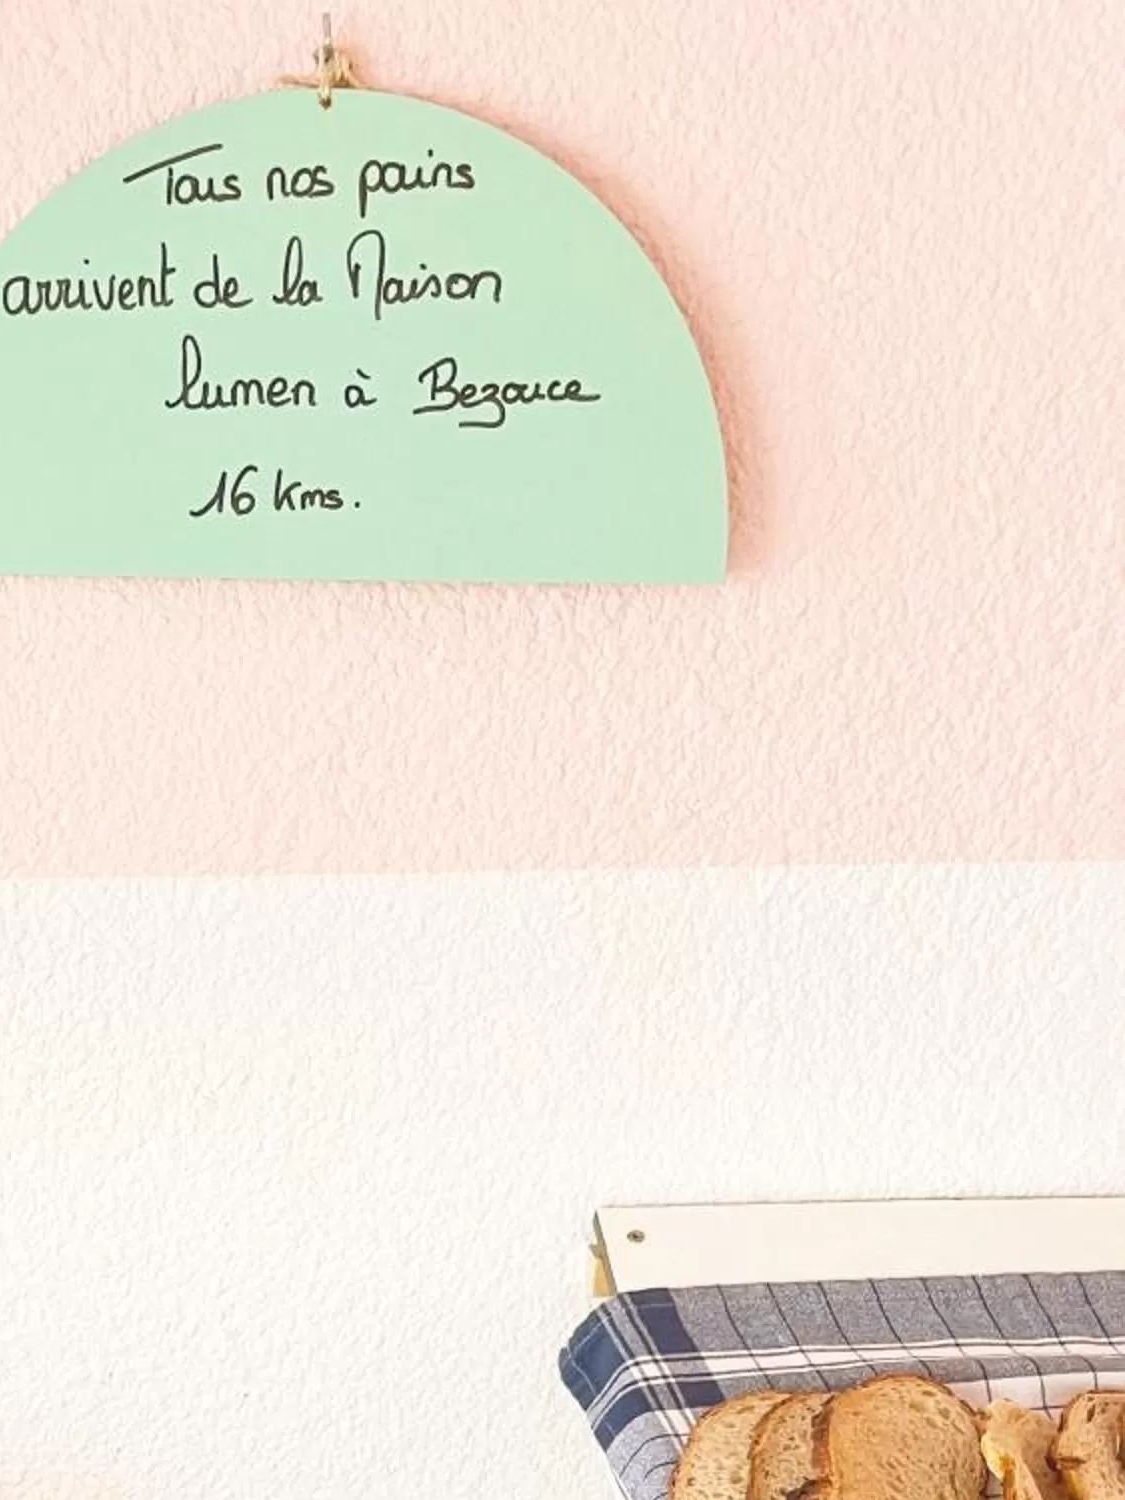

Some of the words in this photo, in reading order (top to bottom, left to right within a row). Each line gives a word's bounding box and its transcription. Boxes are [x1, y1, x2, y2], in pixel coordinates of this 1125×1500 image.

[122, 143, 242, 206] Tous
[266, 164, 335, 201] nos
[358, 148, 476, 219] pains
[2, 241, 177, 316] arrivent
[193, 253, 254, 309] de
[272, 235, 323, 307] la
[346, 229, 502, 321] Maison
[344, 368, 378, 409] à
[412, 356, 602, 429] Bezouce
[189, 464, 258, 518] 16
